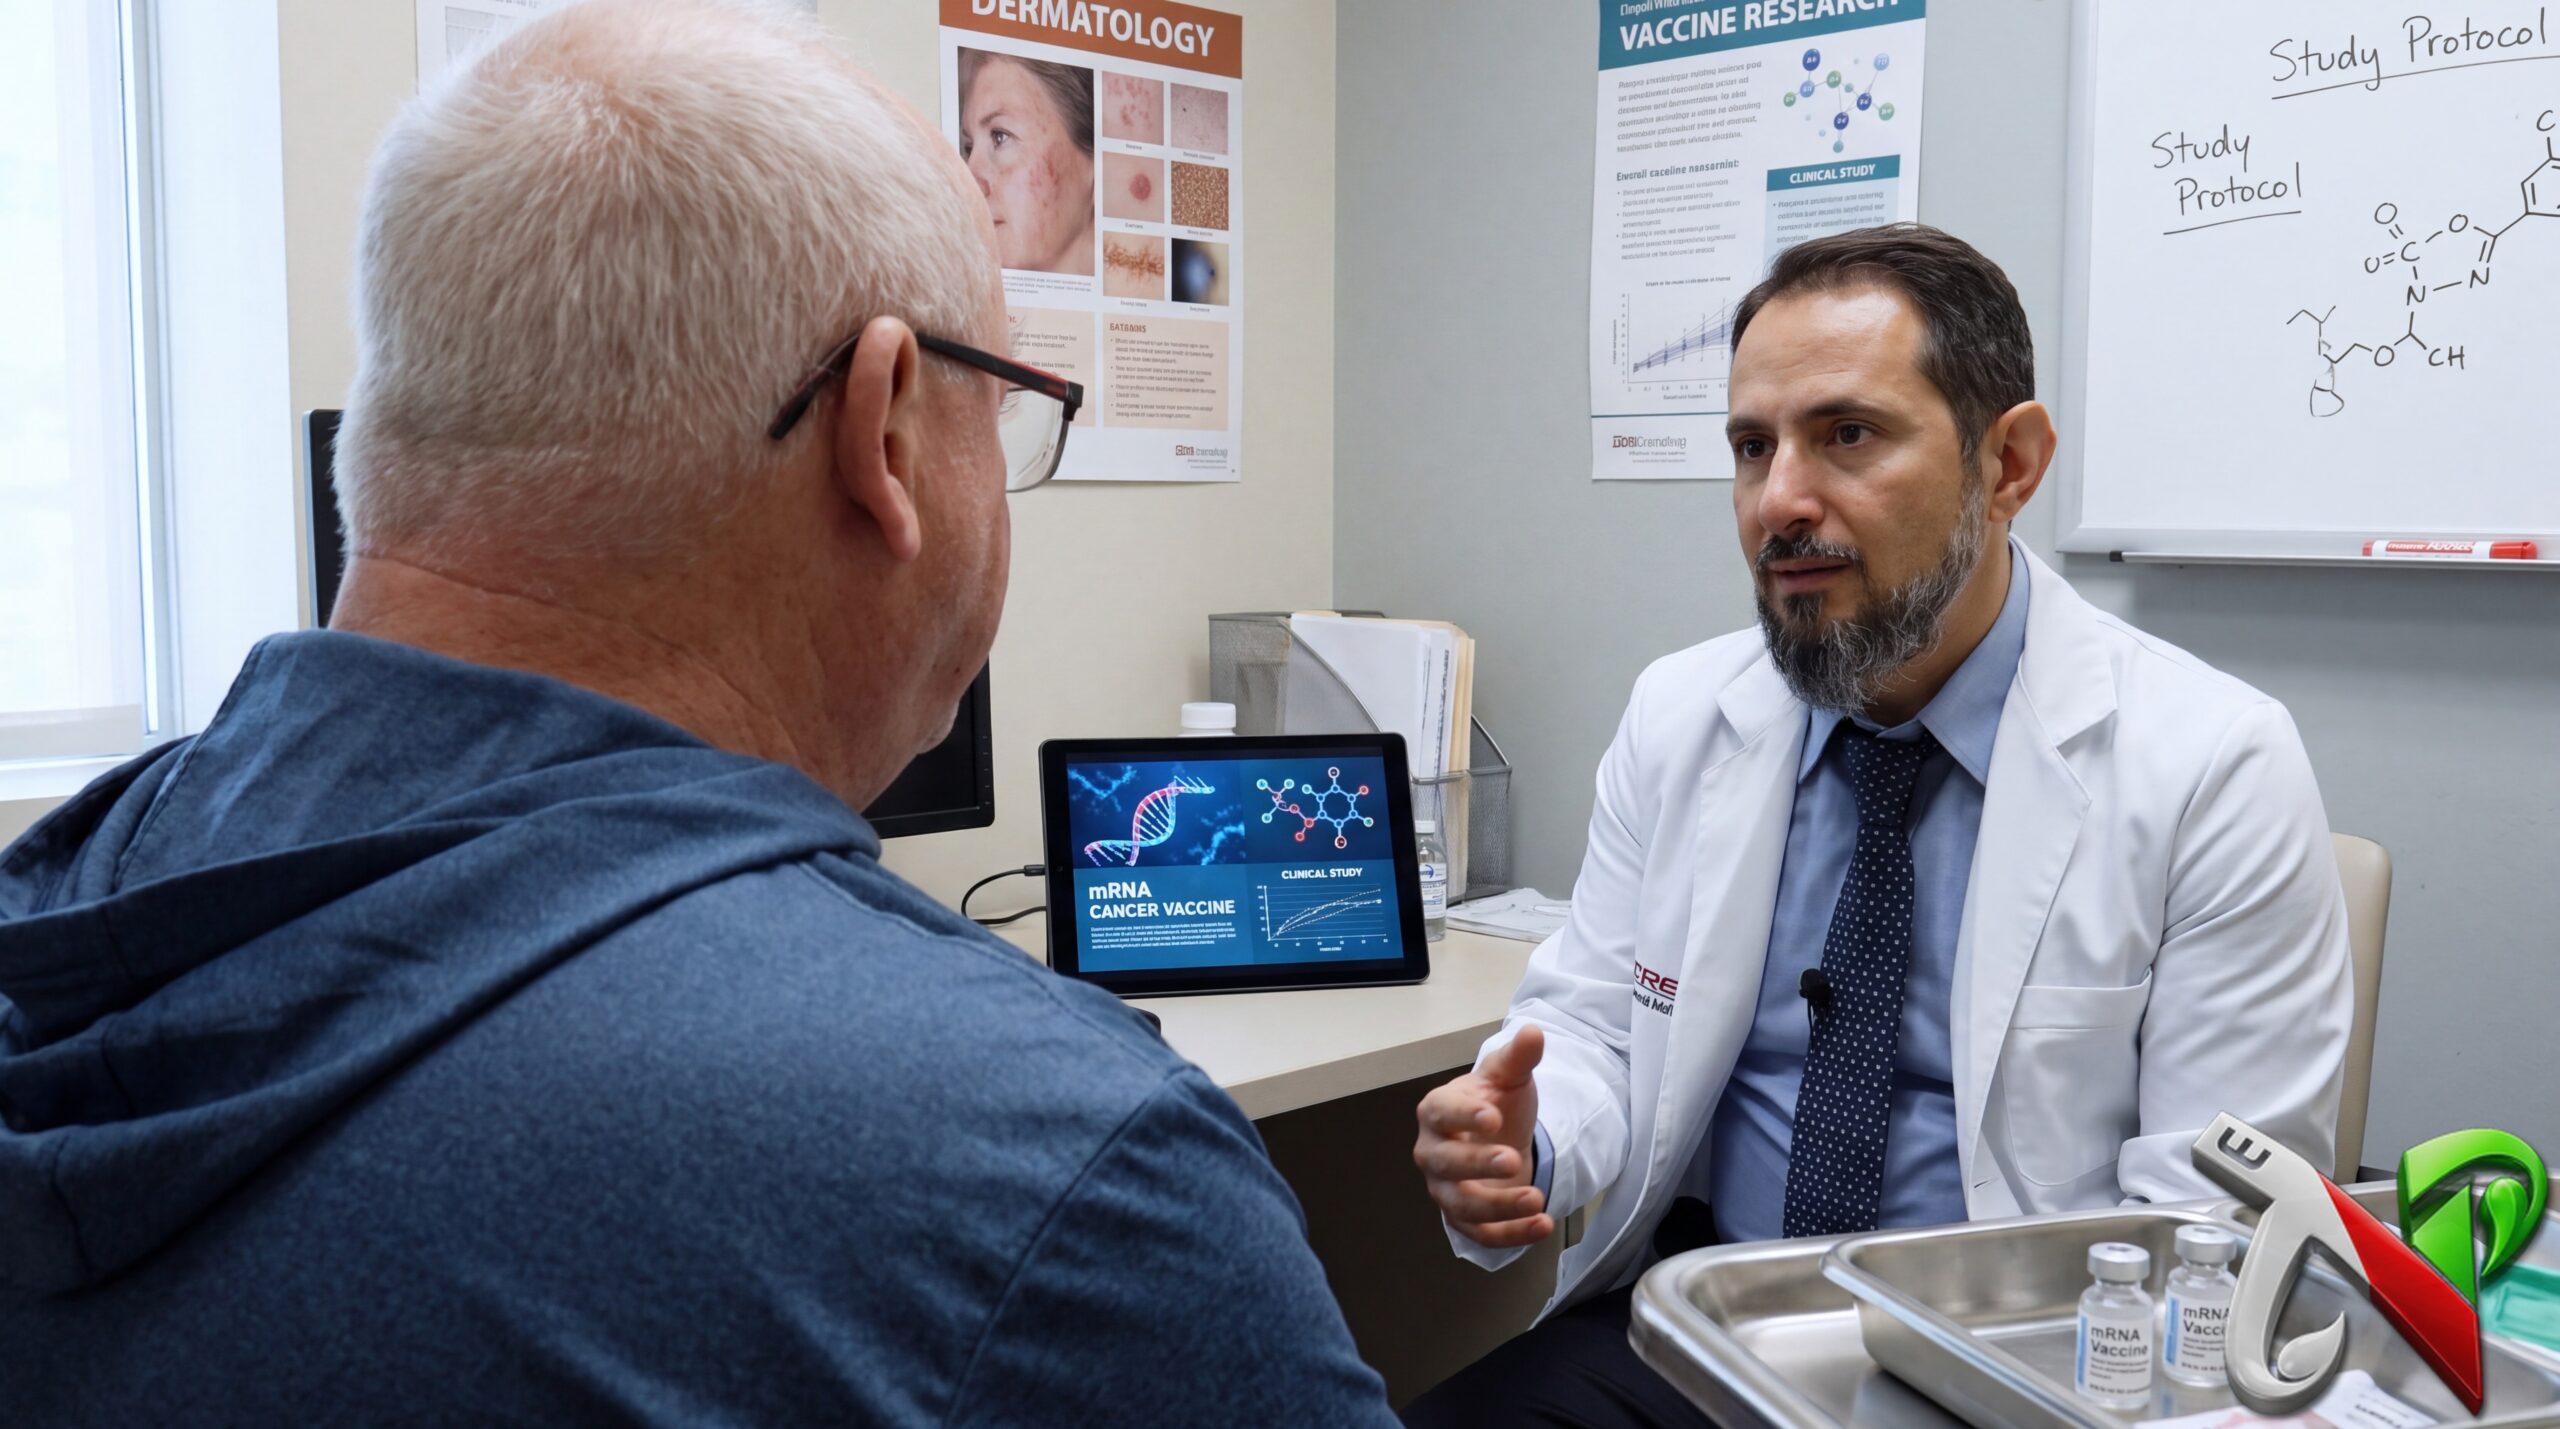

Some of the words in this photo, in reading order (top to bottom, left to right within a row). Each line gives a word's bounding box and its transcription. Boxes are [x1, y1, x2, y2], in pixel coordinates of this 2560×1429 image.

[1620, 6, 1737, 51] VACCINE
[1744, 0, 1899, 31] RESEAR
[2270, 34, 2381, 91] Study
[2402, 6, 2546, 62] Protocol
[2151, 123, 2250, 173] Study
[1789, 168, 1838, 185] CLINICAL
[1839, 163, 1876, 180] STUDY
[2174, 161, 2301, 216] Protocol
[1281, 869, 1328, 880] CLINICAL
[1329, 867, 1363, 878] STUDY
[1089, 881, 1152, 900] mRNA
[1089, 903, 1160, 919] CANCER
[1163, 899, 1236, 917] VACCINE
[2184, 1307, 2229, 1320] mRNA
[2091, 1327, 2141, 1342] mRNA
[2183, 1319, 2226, 1336] Vacci
[2091, 1339, 2148, 1357] Vaccine
